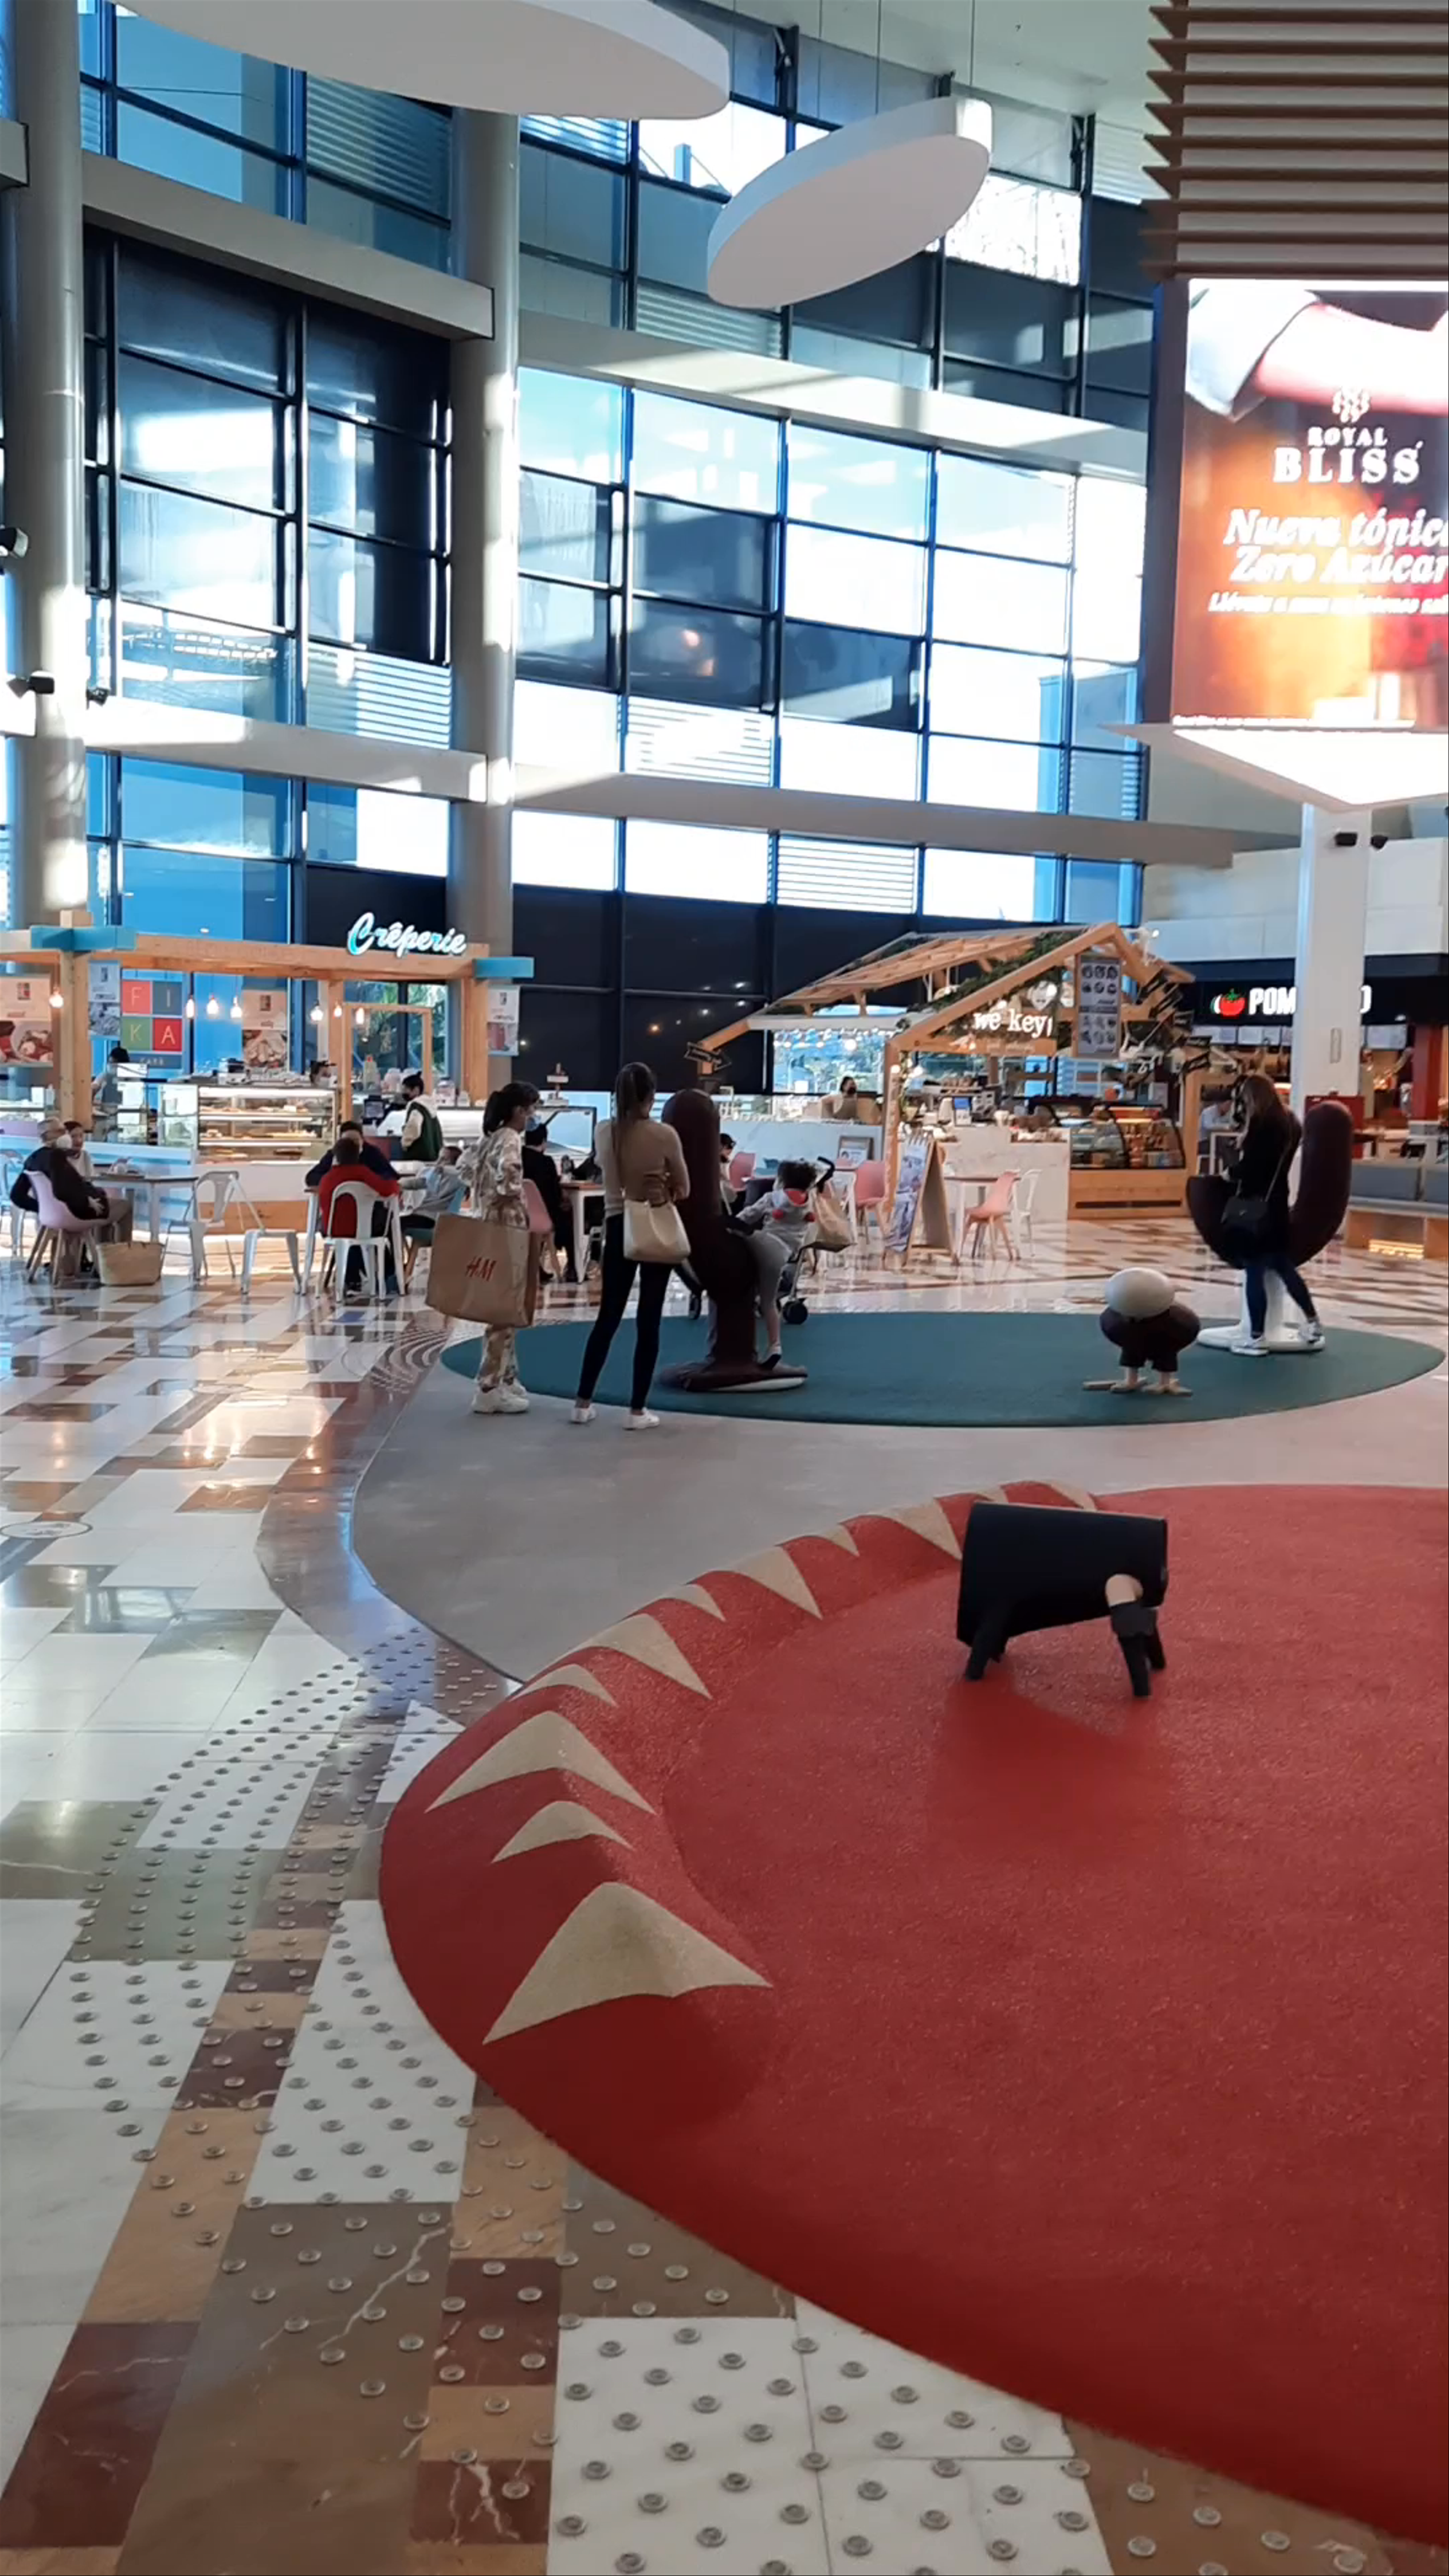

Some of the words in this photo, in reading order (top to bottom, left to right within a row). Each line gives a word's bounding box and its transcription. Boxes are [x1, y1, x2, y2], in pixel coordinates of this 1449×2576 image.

[1307, 427, 1388, 446] ROYAL
[1273, 444, 1421, 483] BLISS
[348, 912, 467, 958] Crêperie
[973, 1012, 1001, 1030] we
